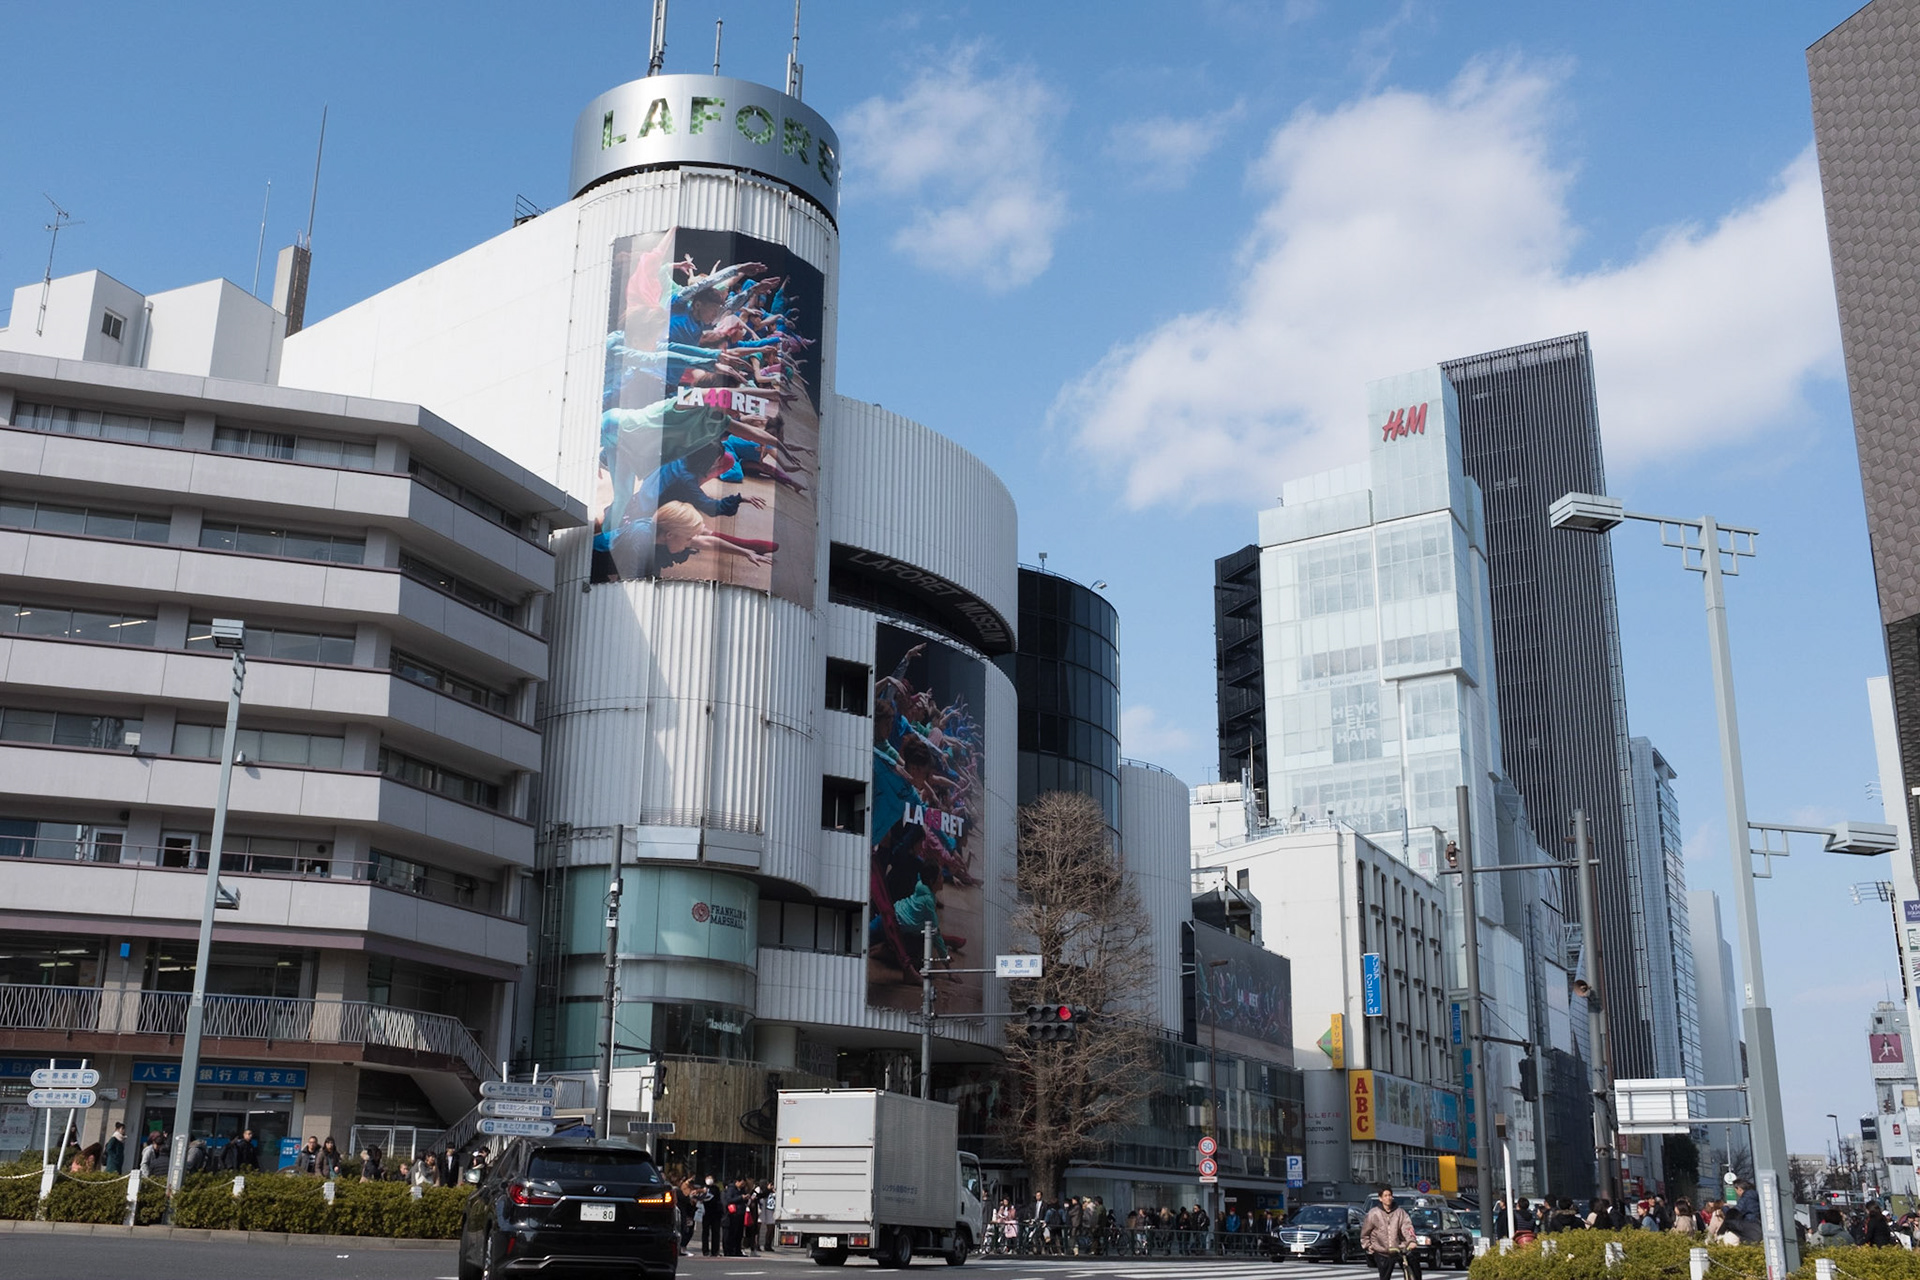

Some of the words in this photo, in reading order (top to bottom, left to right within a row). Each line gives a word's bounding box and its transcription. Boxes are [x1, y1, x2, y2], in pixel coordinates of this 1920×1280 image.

[1382, 402, 1428, 442] H&M
[710, 905, 743, 919] FRANKLIN
[710, 914, 744, 929] MARSHALL
[1000, 959, 1038, 968] 神宮前
[1372, 955, 1380, 980] アリシア
[1366, 973, 1374, 1005] クリニック
[142, 1066, 297, 1084] 八千銀行原宿支店
[1203, 1142, 1213, 1151] 50
[1289, 1158, 1299, 1170] P
